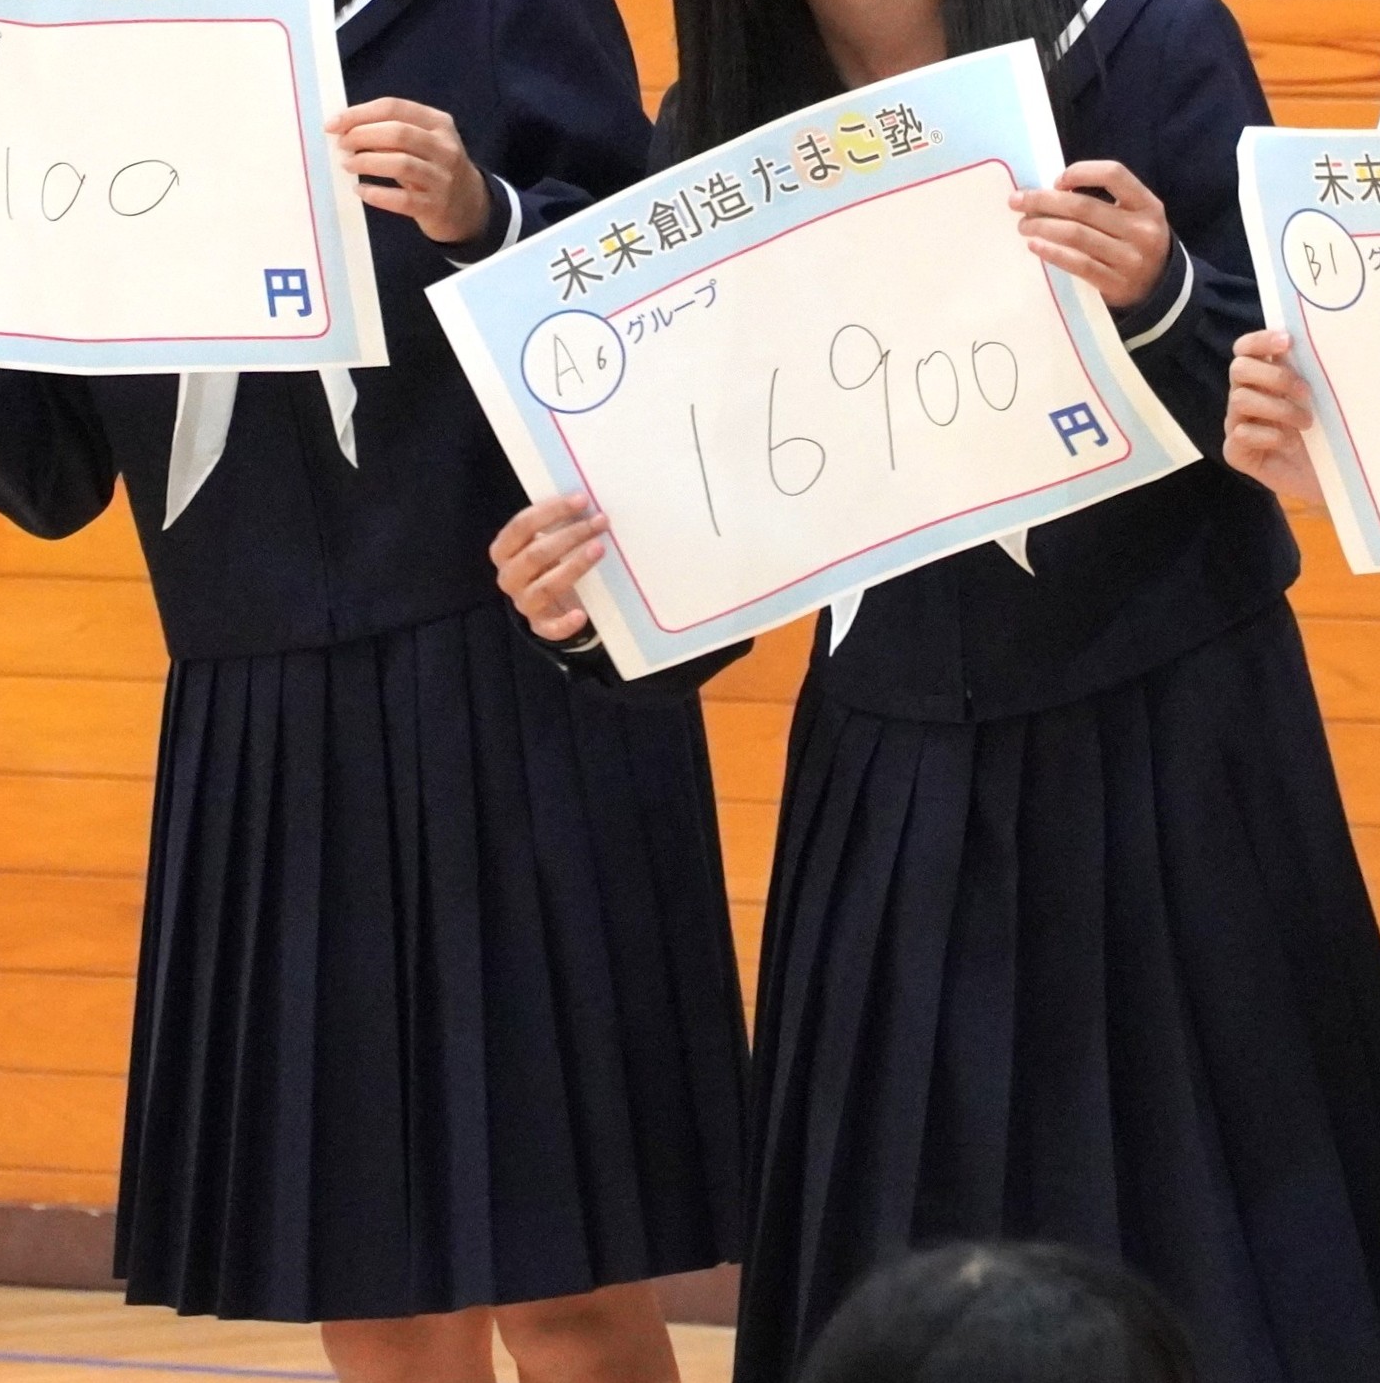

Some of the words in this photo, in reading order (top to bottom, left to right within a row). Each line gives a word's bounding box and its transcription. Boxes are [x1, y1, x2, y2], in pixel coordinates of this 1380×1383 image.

[263, 268, 313, 319] 円
[552, 333, 608, 396] A6
[626, 278, 719, 344] グループ
[690, 323, 1019, 537] 16900
[1048, 400, 1111, 457] 円
